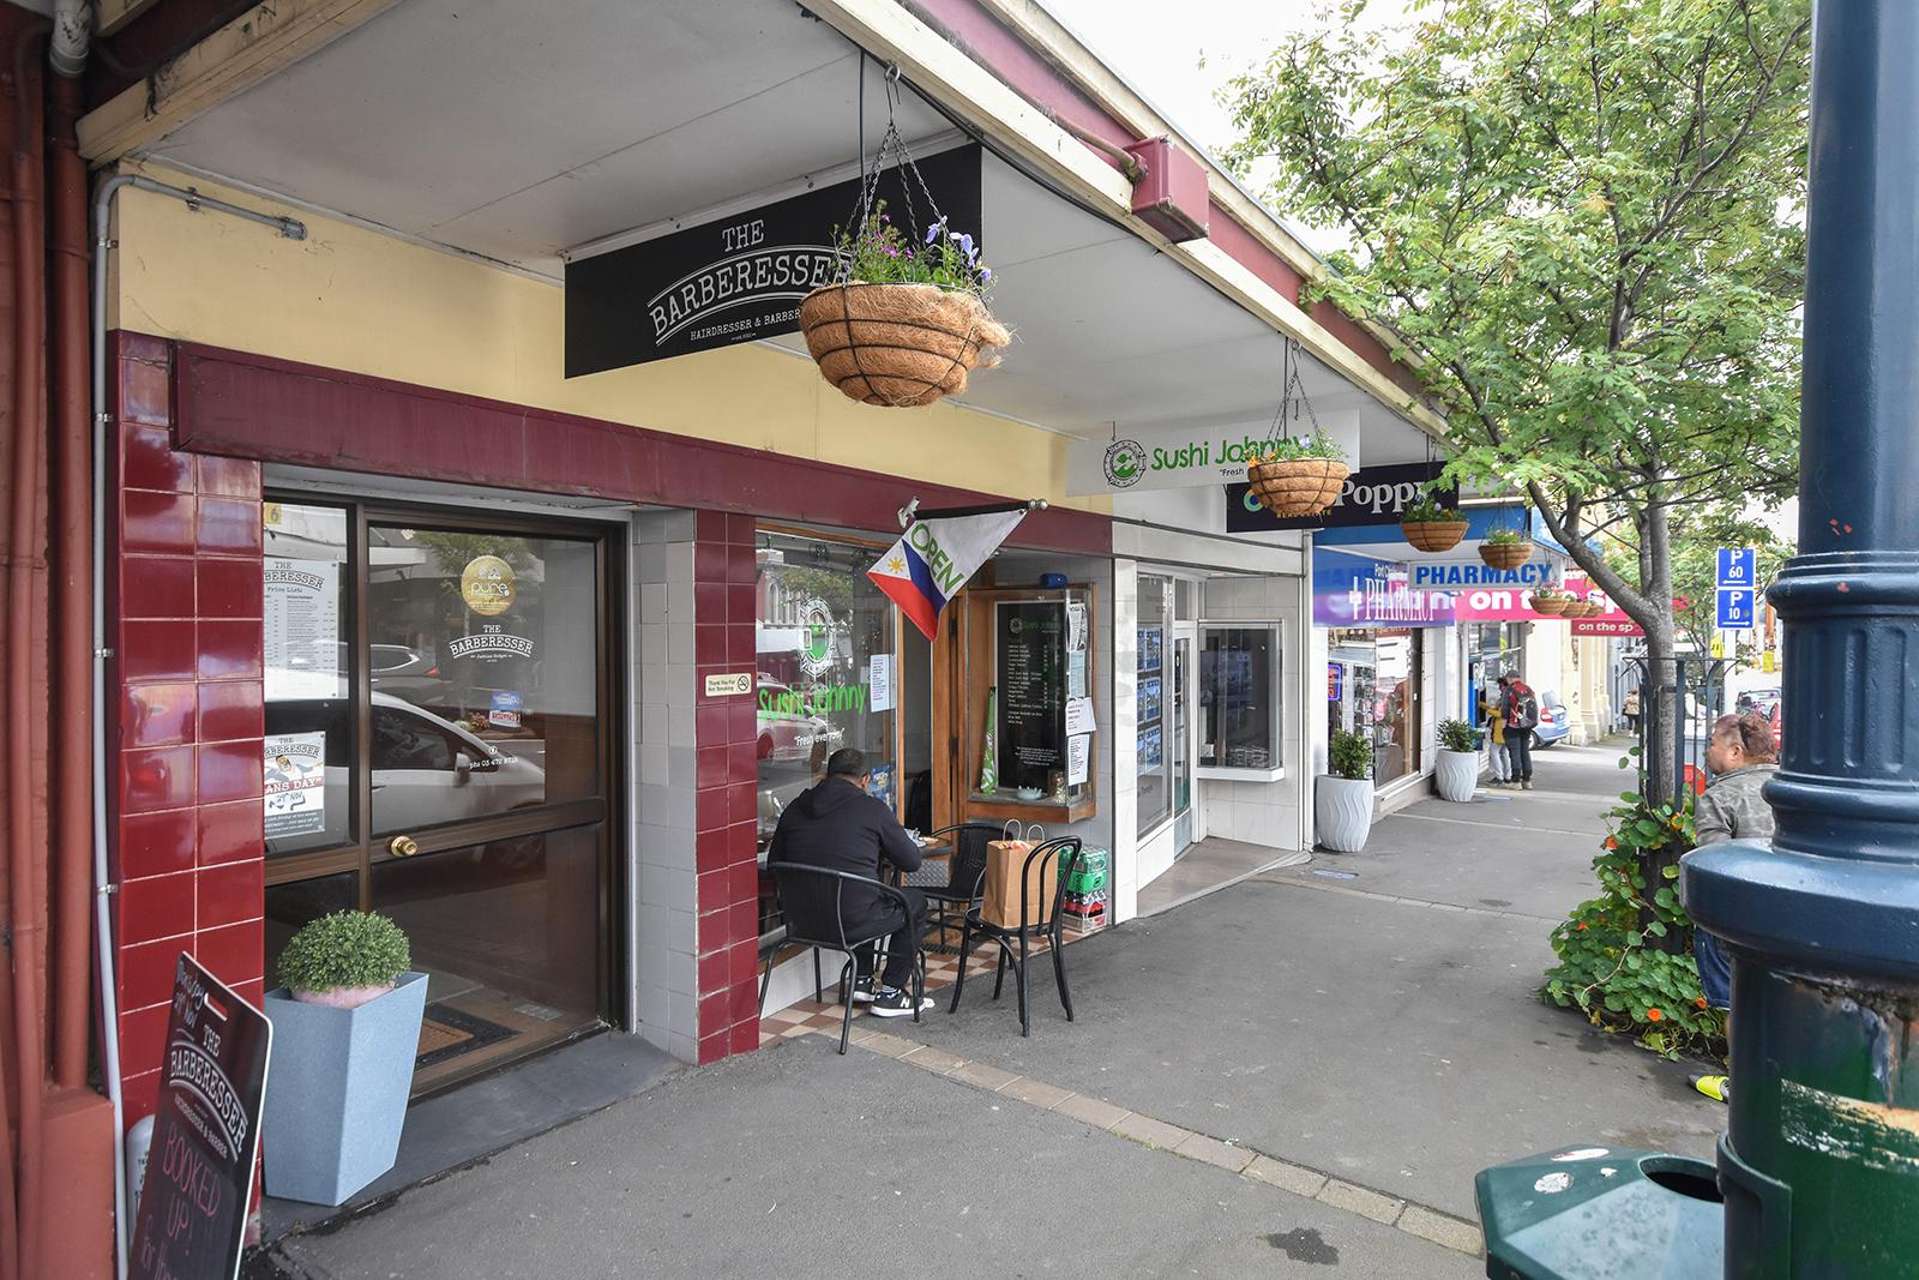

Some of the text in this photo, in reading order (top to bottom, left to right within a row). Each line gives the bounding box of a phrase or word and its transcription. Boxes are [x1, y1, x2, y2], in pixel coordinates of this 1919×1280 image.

[722, 219, 765, 253] THE
[690, 318, 752, 341] HAIRDRESSER
[754, 316, 761, 328] &
[1150, 440, 1209, 471] Sushi
[910, 522, 965, 594] OPEN
[1730, 550, 1744, 565] P
[1416, 563, 1553, 585] PHARMACY
[1728, 565, 1744, 578] 60
[1470, 590, 1513, 611] on
[1730, 591, 1744, 607] P
[1728, 607, 1741, 620] 10
[482, 624, 501, 633] THE
[1578, 623, 1594, 631] on
[1596, 622, 1616, 631] the
[450, 636, 533, 656] BARBERESSER
[203, 1023, 222, 1057] THE
[171, 1049, 247, 1154] BARBERESSER
[163, 1121, 222, 1217] BOOKED
